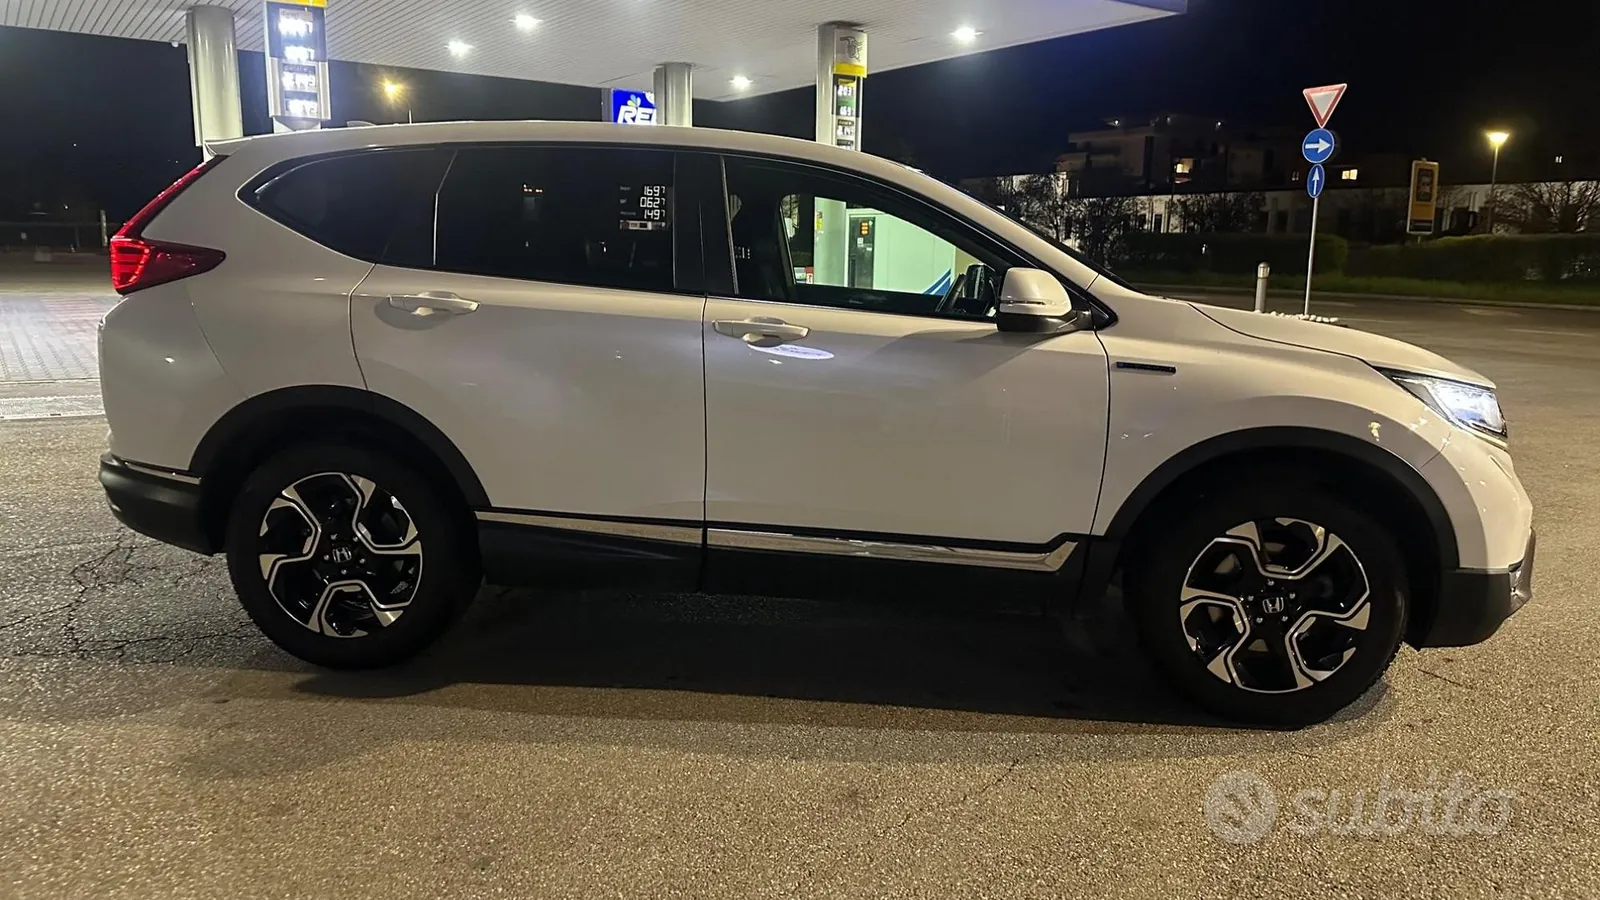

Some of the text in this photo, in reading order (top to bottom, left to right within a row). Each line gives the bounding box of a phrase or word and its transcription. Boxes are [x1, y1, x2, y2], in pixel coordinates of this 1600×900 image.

[643, 185, 666, 196] 1697
[640, 196, 666, 209] 0627
[643, 209, 666, 220] 1497
